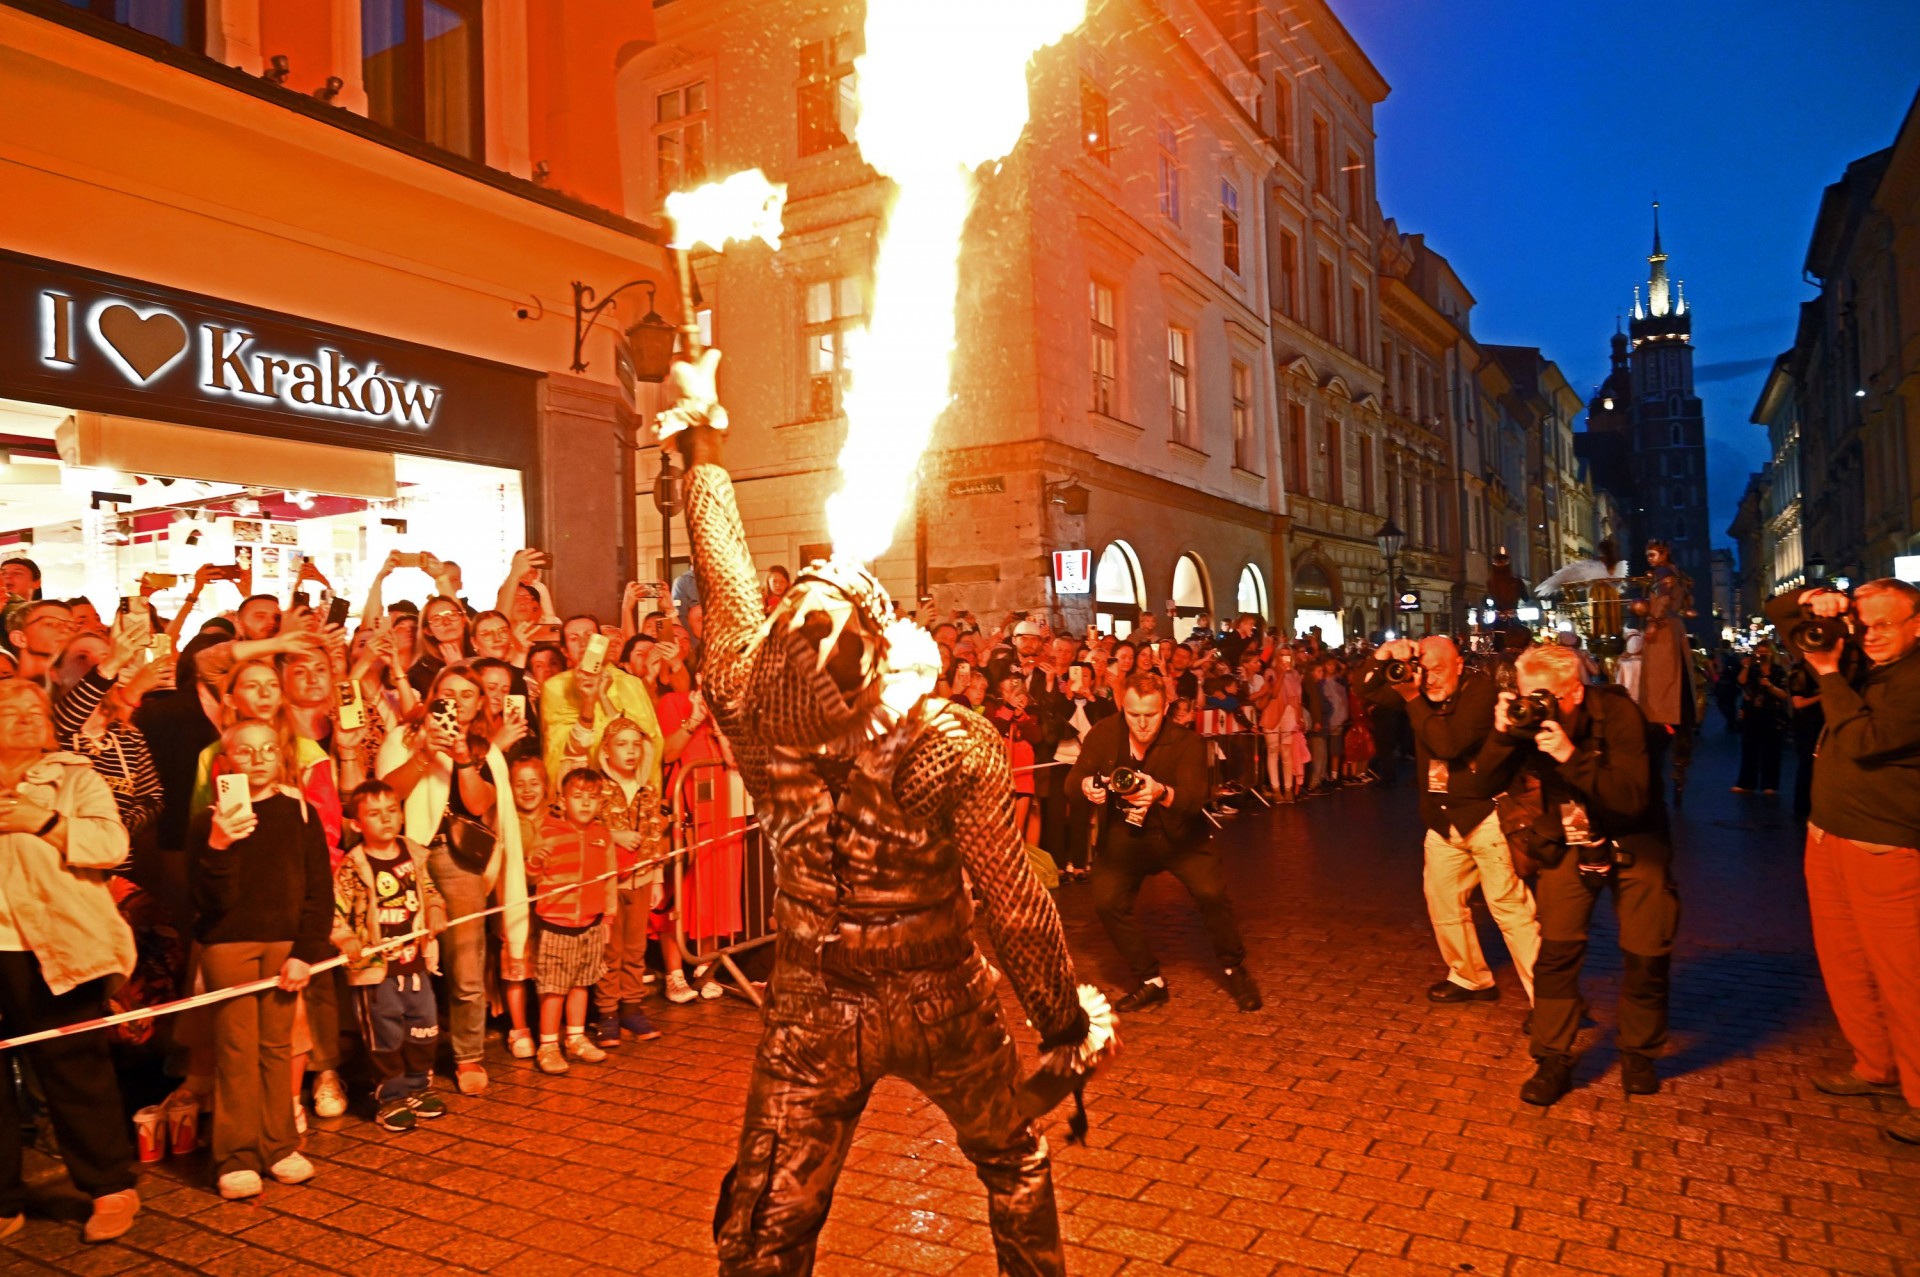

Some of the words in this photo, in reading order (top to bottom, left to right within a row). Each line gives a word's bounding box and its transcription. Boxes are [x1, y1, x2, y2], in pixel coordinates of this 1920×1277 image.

[43, 291, 77, 366] I
[202, 324, 441, 424] Kraków
[379, 908, 407, 923] AVE
